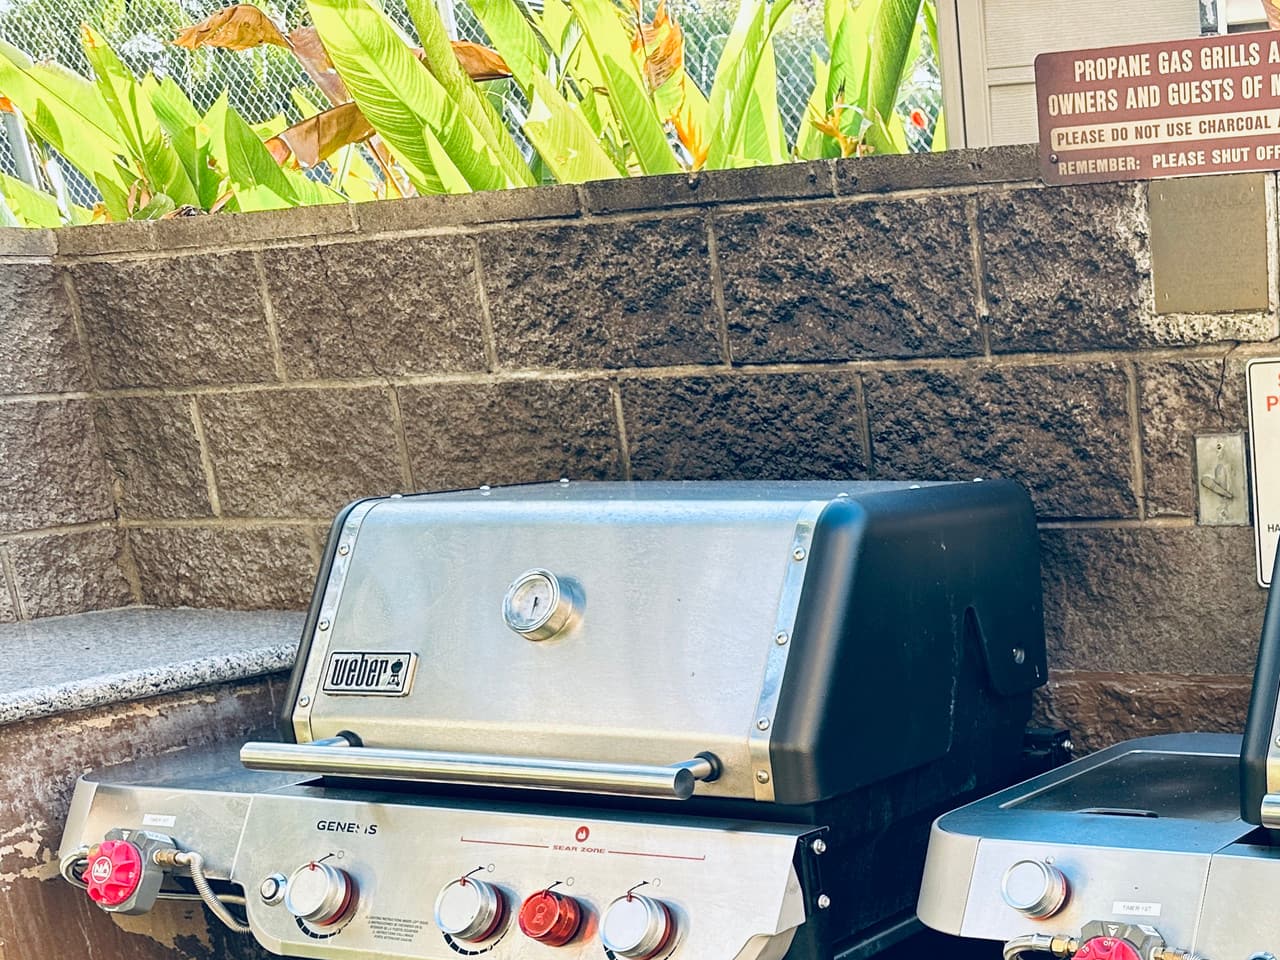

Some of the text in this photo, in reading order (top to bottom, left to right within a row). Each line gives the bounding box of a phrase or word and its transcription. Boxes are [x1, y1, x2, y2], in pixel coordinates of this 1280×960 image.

[1074, 53, 1151, 82] PROPANE
[1158, 49, 1193, 73] GAS
[1200, 42, 1261, 70] GRILLS
[1048, 90, 1118, 117] OWNERS
[1125, 86, 1161, 110] AND
[1168, 80, 1234, 106] GUESTS
[1241, 75, 1264, 99] OF
[1057, 129, 1105, 147] PLEASE
[1111, 127, 1128, 142] DO
[1135, 124, 1160, 140] NOT
[1166, 121, 1192, 137] USE
[1199, 115, 1271, 135] CHARCOAL
[1058, 155, 1141, 176] REMEMBER:
[1152, 149, 1205, 169] PLEASE
[1211, 146, 1249, 165] SHUT
[331, 653, 389, 687] weber
